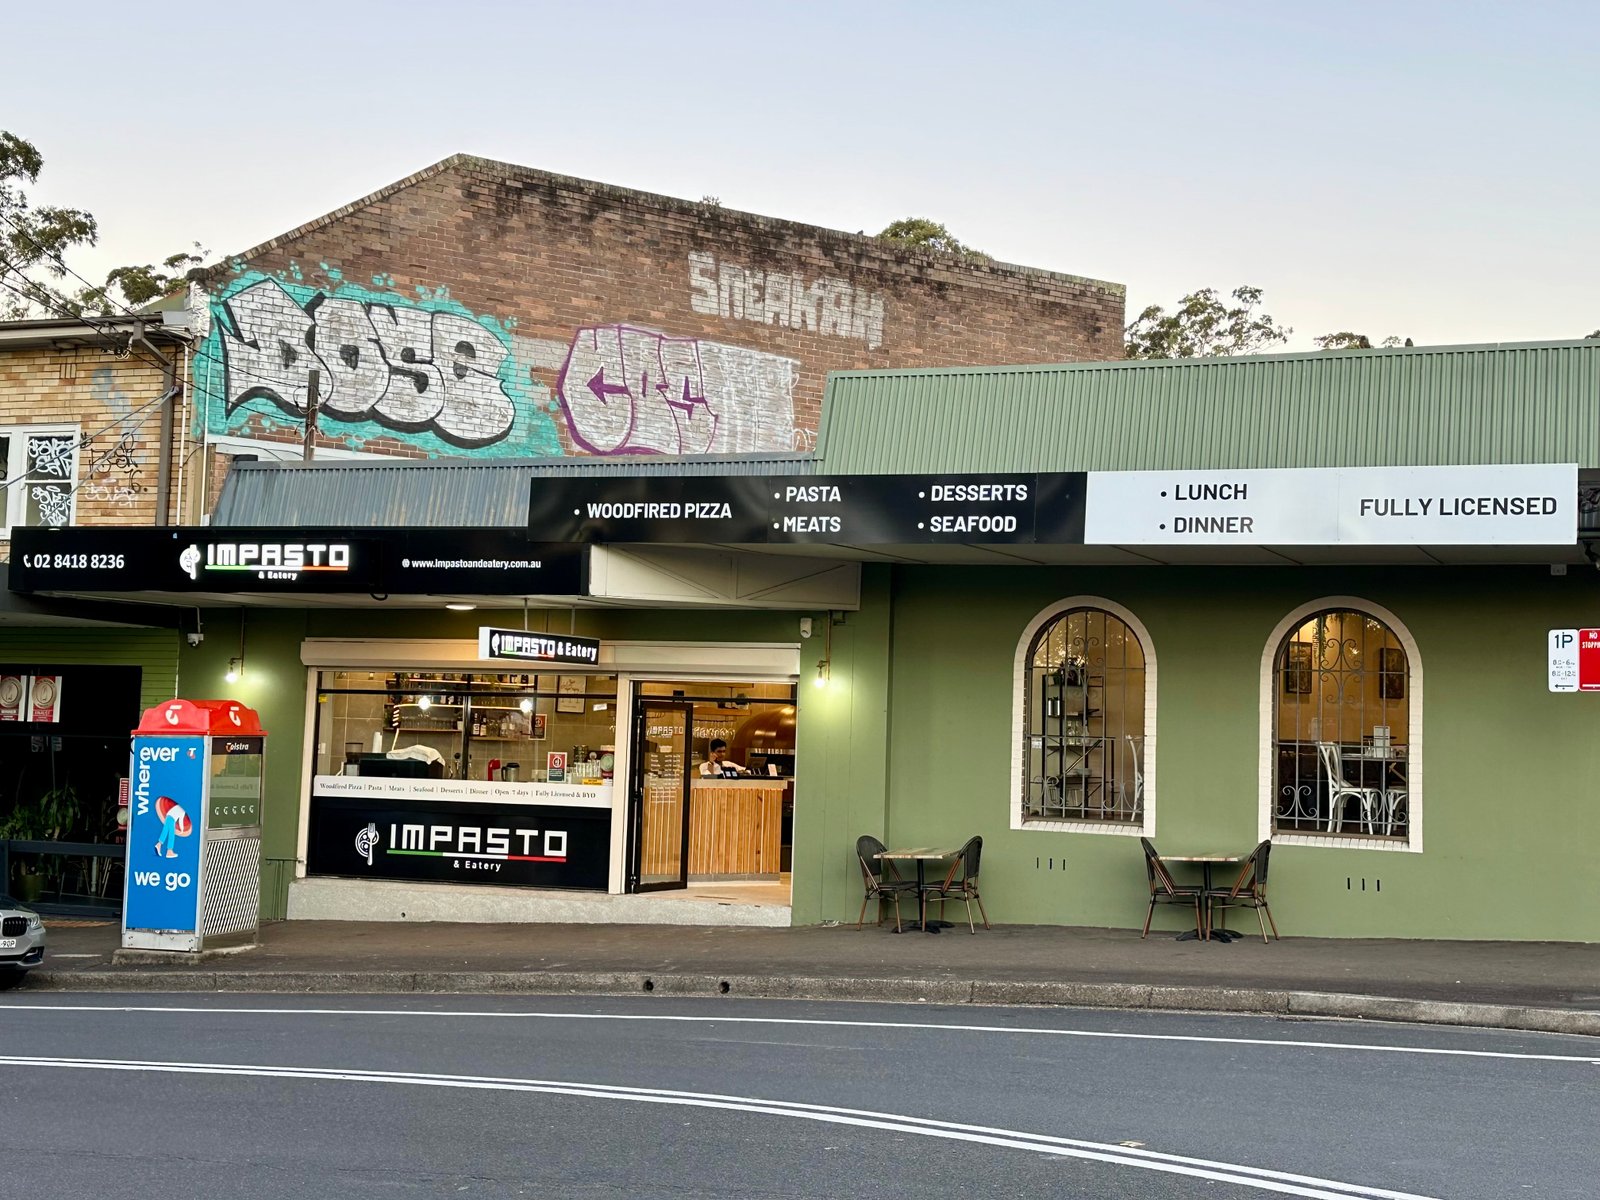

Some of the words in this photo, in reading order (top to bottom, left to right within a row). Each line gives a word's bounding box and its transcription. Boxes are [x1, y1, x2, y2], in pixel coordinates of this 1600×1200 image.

[785, 485, 842, 502] PASTA
[930, 484, 1028, 502] DESSERTS
[1176, 483, 1248, 501] LUNCH
[586, 502, 681, 519] WOODFIRED
[684, 502, 733, 519] PIZZA
[1360, 498, 1433, 517] FULLY
[1439, 497, 1557, 516] LICENSED
[783, 516, 842, 533] MEATS
[929, 515, 1017, 533] SEAFOOD
[1174, 516, 1254, 534] DINNER
[34, 553, 51, 569] 02
[53, 553, 88, 569] 8418
[90, 554, 125, 569] 8236
[207, 544, 350, 566] IMPASTO
[411, 558, 542, 571] www.impastoandeatery.com.au
[258, 571, 265, 579] &
[267, 571, 298, 581] Eatery
[1555, 633, 1573, 649] 1P
[1588, 632, 1599, 640] NO
[501, 635, 556, 656] IMPASTO
[557, 641, 564, 655] &
[565, 642, 598, 662] Eatery
[551, 790, 575, 798] Licensed
[390, 823, 568, 857] IMPASTO
[453, 860, 460, 869] &
[465, 860, 502, 873] Eatery
[134, 871, 161, 887] we
[165, 872, 191, 892] go
